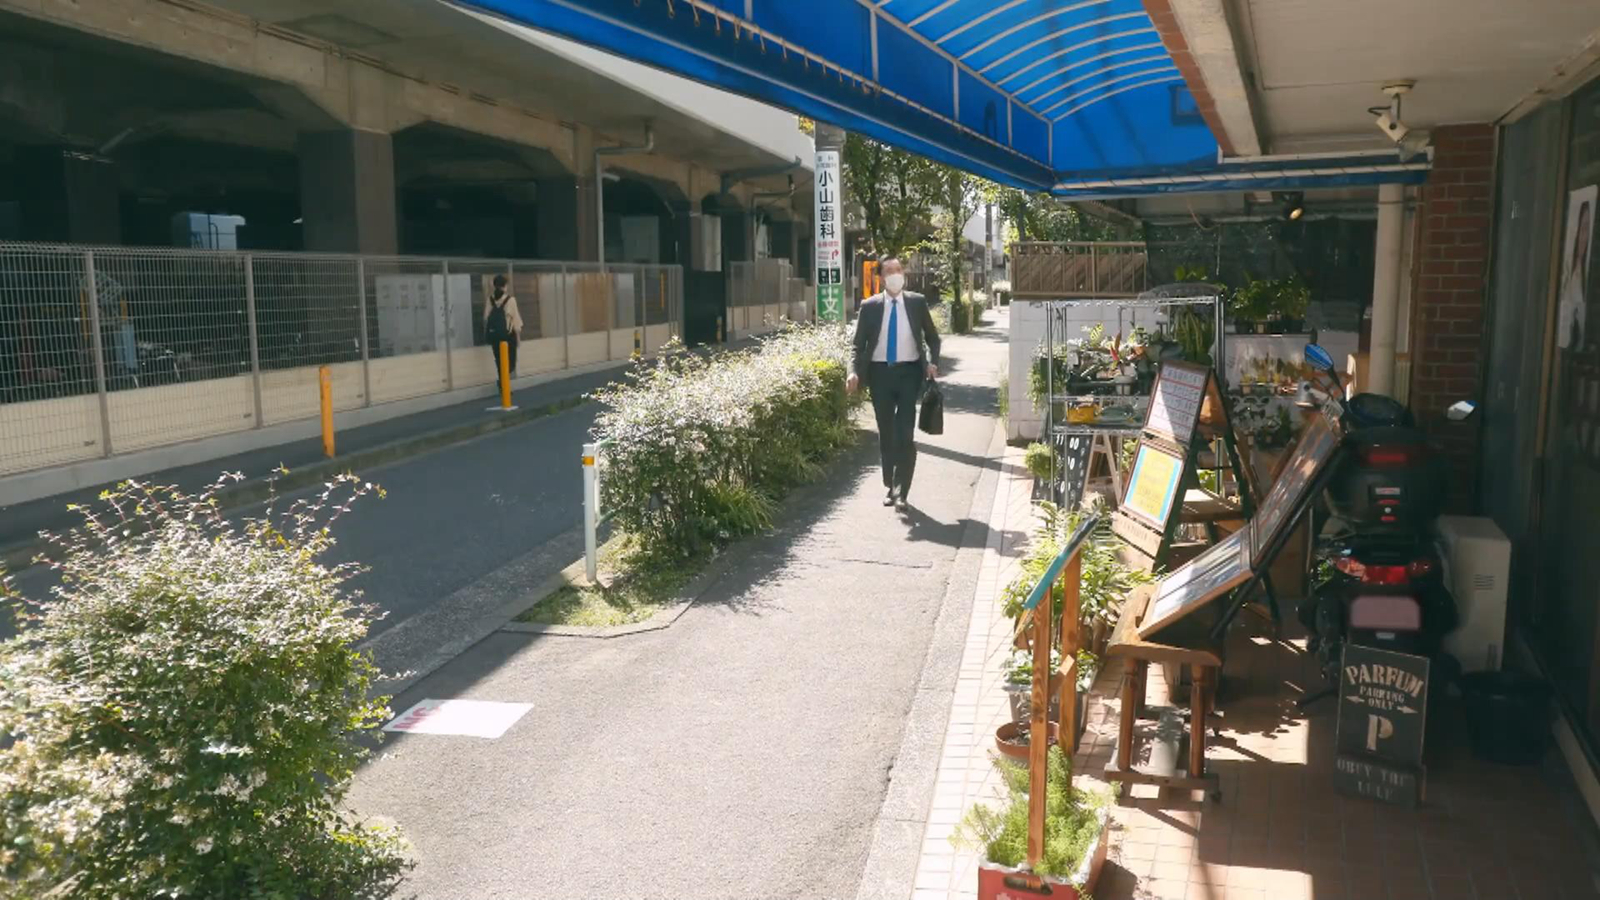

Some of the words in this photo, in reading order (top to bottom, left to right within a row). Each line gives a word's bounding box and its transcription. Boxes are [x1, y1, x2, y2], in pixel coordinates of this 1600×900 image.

[819, 170, 835, 239] 小山歯科
[1345, 663, 1424, 698] PARFUM
[1360, 686, 1405, 703] PARKING
[1368, 697, 1394, 710] ONLY
[1366, 714, 1394, 751] P
